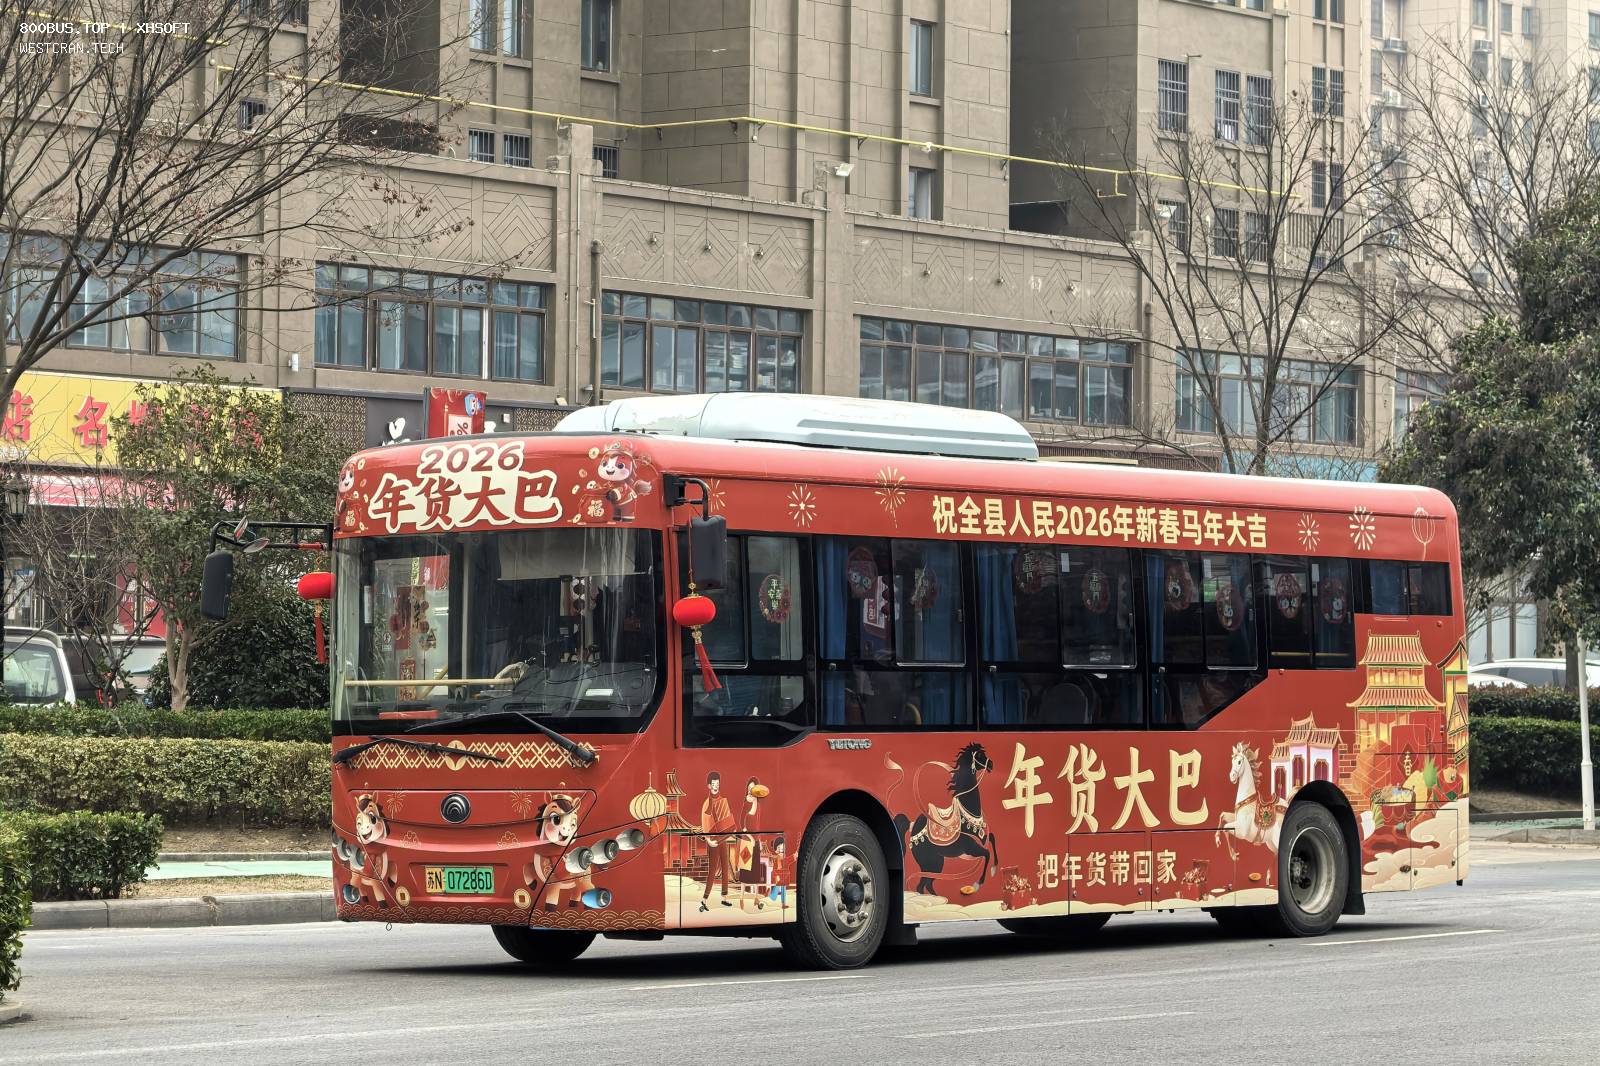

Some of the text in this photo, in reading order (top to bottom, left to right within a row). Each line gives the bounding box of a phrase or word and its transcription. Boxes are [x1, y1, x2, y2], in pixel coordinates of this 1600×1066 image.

[420, 443, 522, 475] 2026
[372, 474, 560, 529] 年货大巴
[932, 494, 1267, 549] 祝全县人民2026年新春马年大吉
[1002, 742, 1209, 839] 年货大巴
[1037, 848, 1177, 889] 把年货带回家
